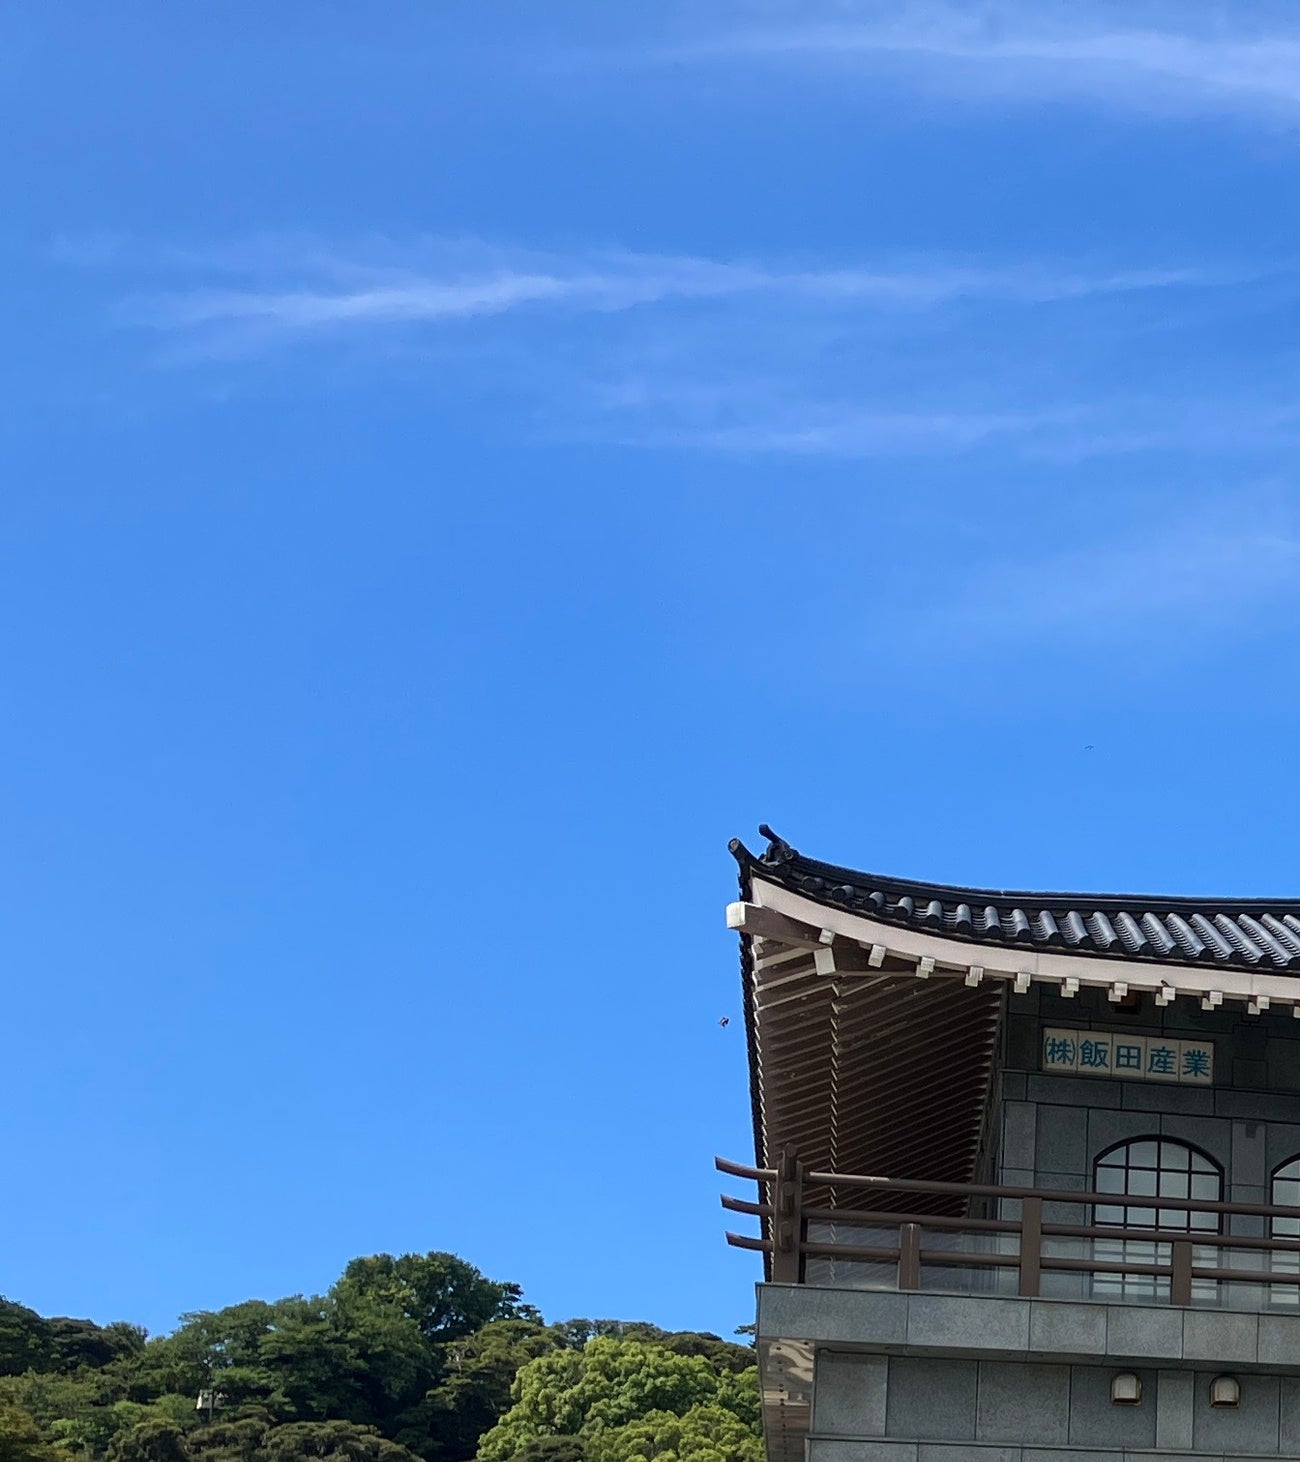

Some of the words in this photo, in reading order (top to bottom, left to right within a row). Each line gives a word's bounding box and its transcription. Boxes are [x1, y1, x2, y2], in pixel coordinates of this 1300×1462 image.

[1044, 1036, 1211, 1078] (株)飯田産業
